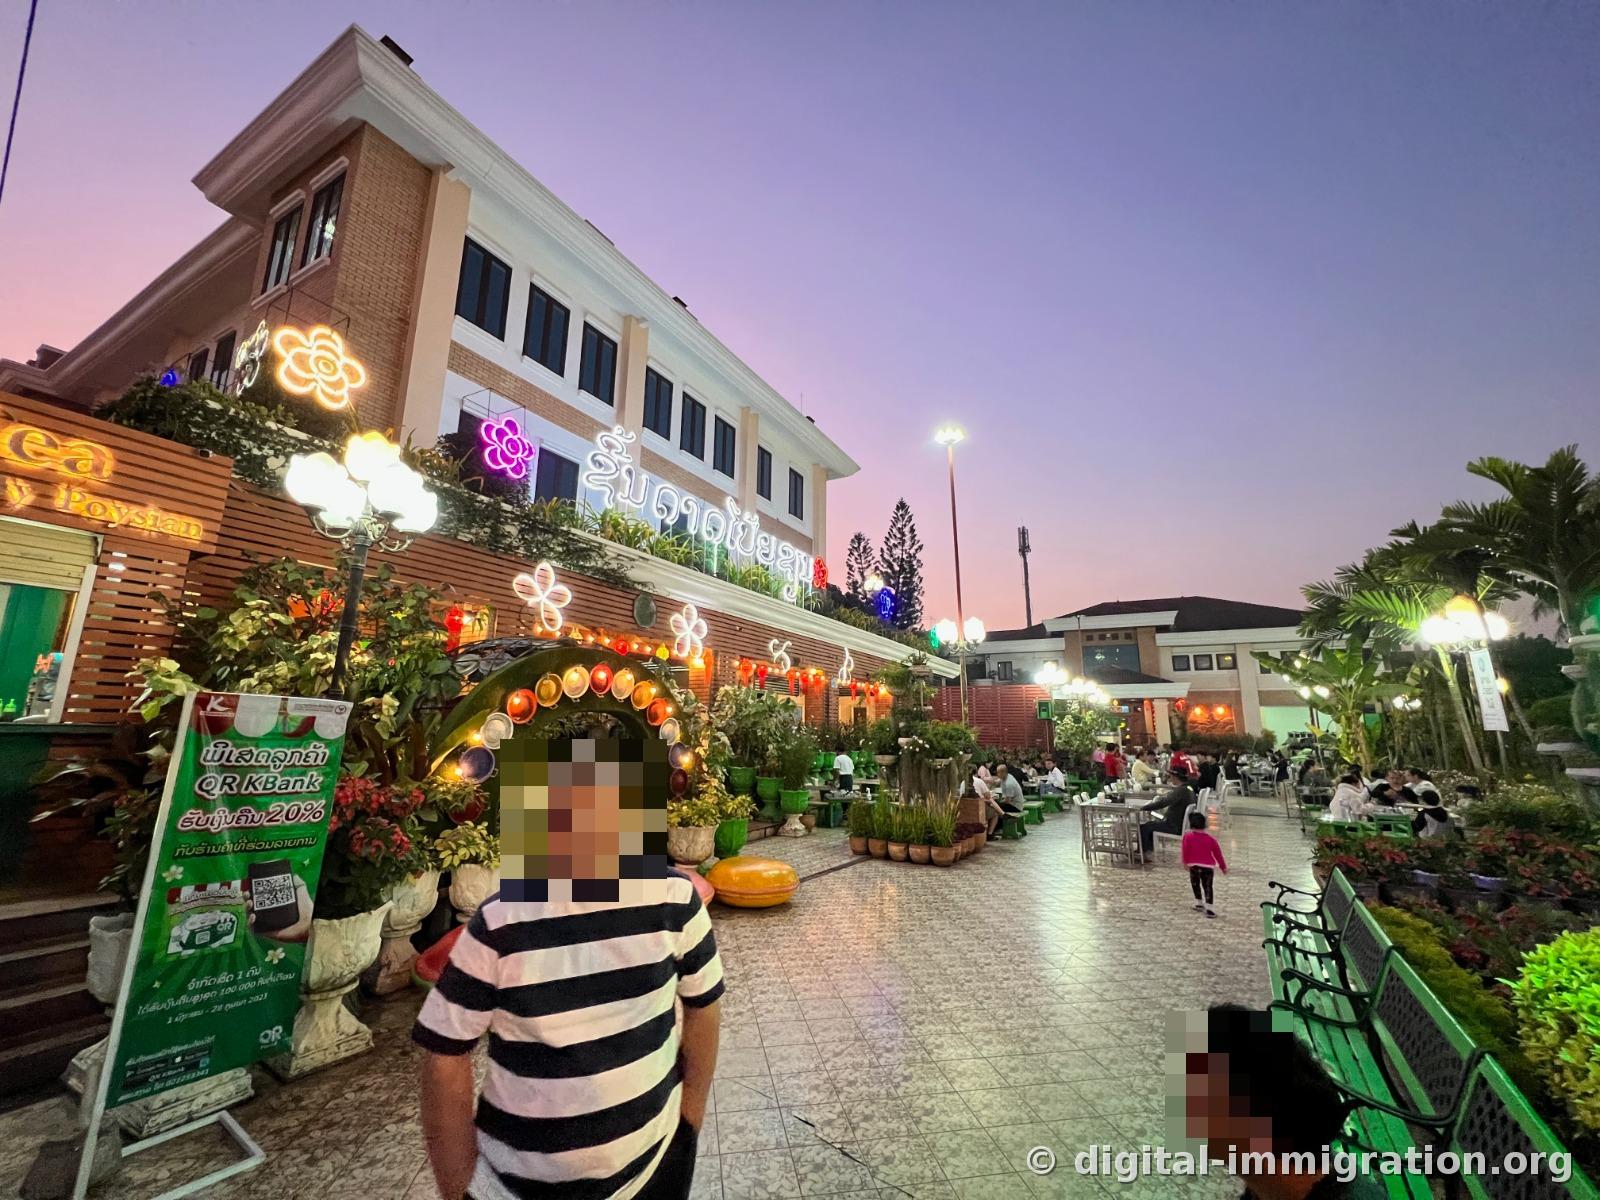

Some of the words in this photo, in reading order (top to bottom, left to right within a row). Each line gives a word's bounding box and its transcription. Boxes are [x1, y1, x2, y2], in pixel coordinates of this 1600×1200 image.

[0, 425, 113, 480] ea
[58, 485, 203, 541] Poysian
[197, 774, 240, 799] QR
[243, 773, 322, 794] KBank
[264, 801, 326, 825] 20%
